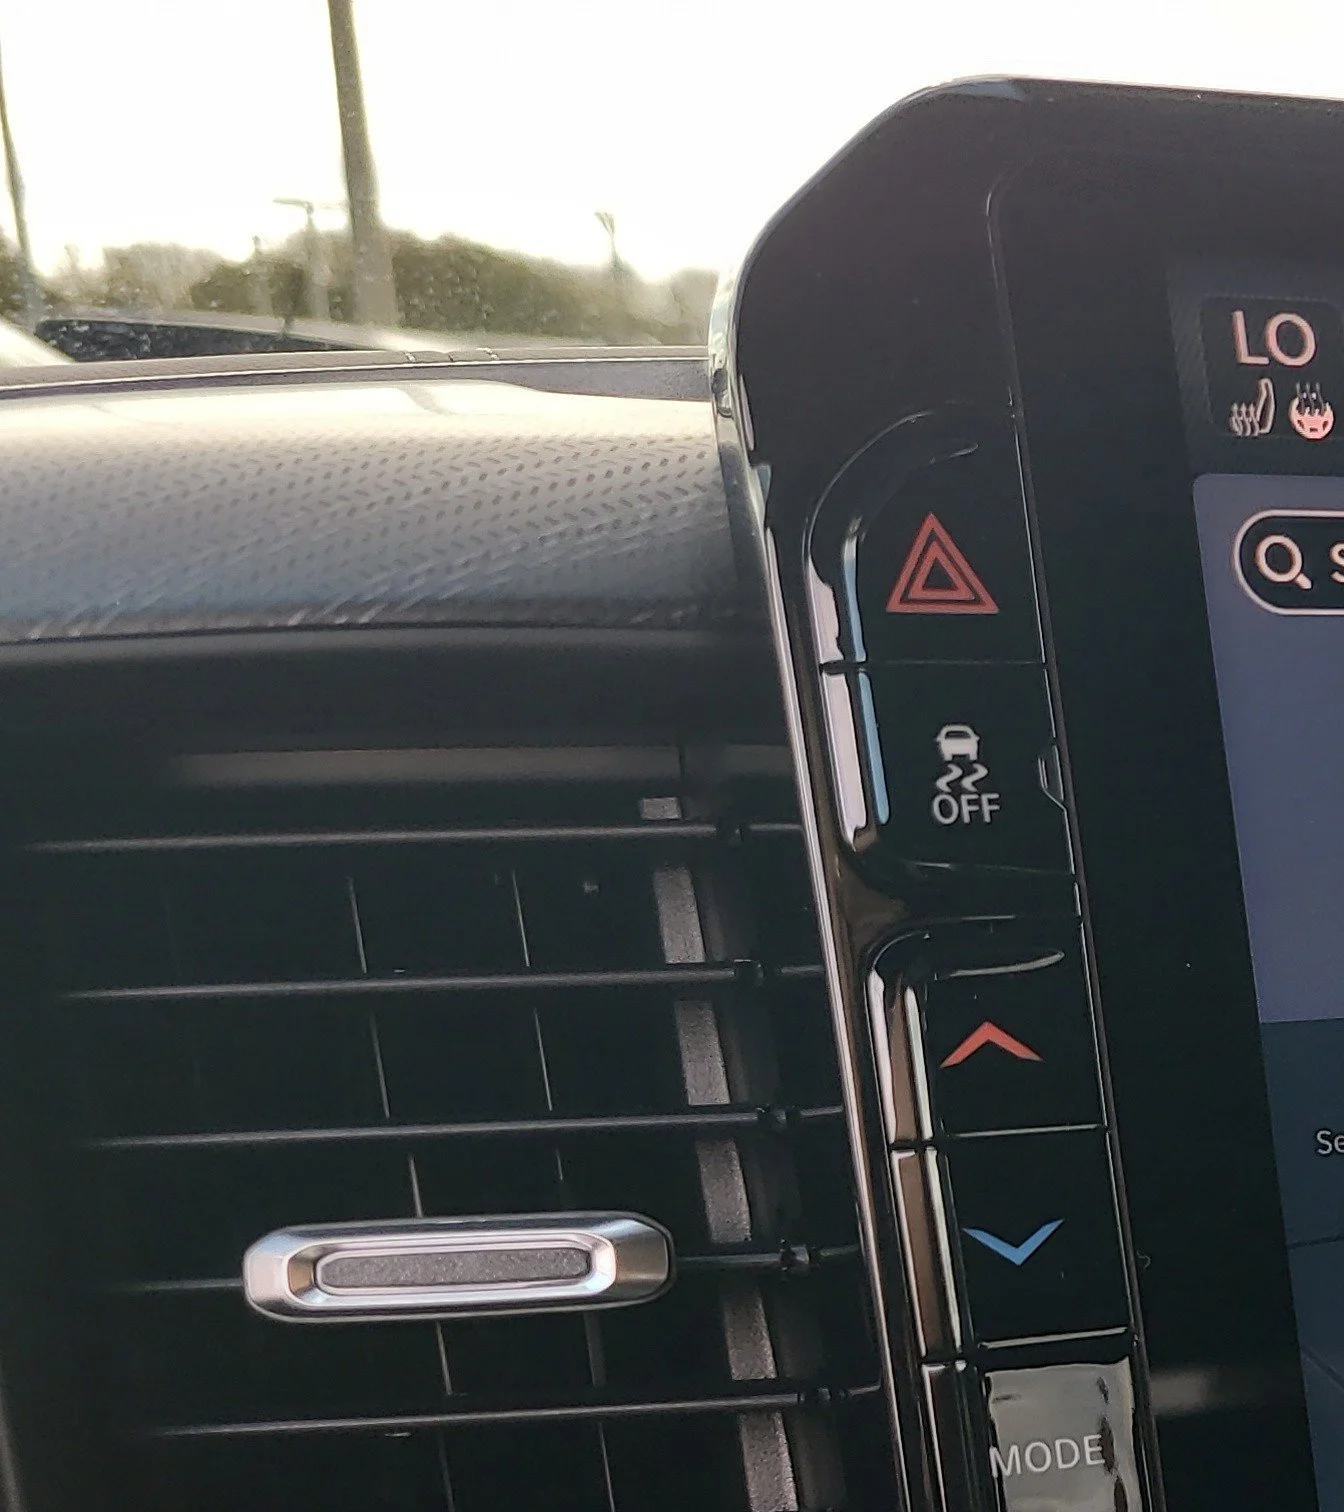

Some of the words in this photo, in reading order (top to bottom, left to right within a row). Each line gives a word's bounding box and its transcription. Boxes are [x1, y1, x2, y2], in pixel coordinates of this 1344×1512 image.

[1229, 309, 1318, 369] LO
[931, 793, 1000, 825] OFF
[989, 1434, 1107, 1479] MODE
